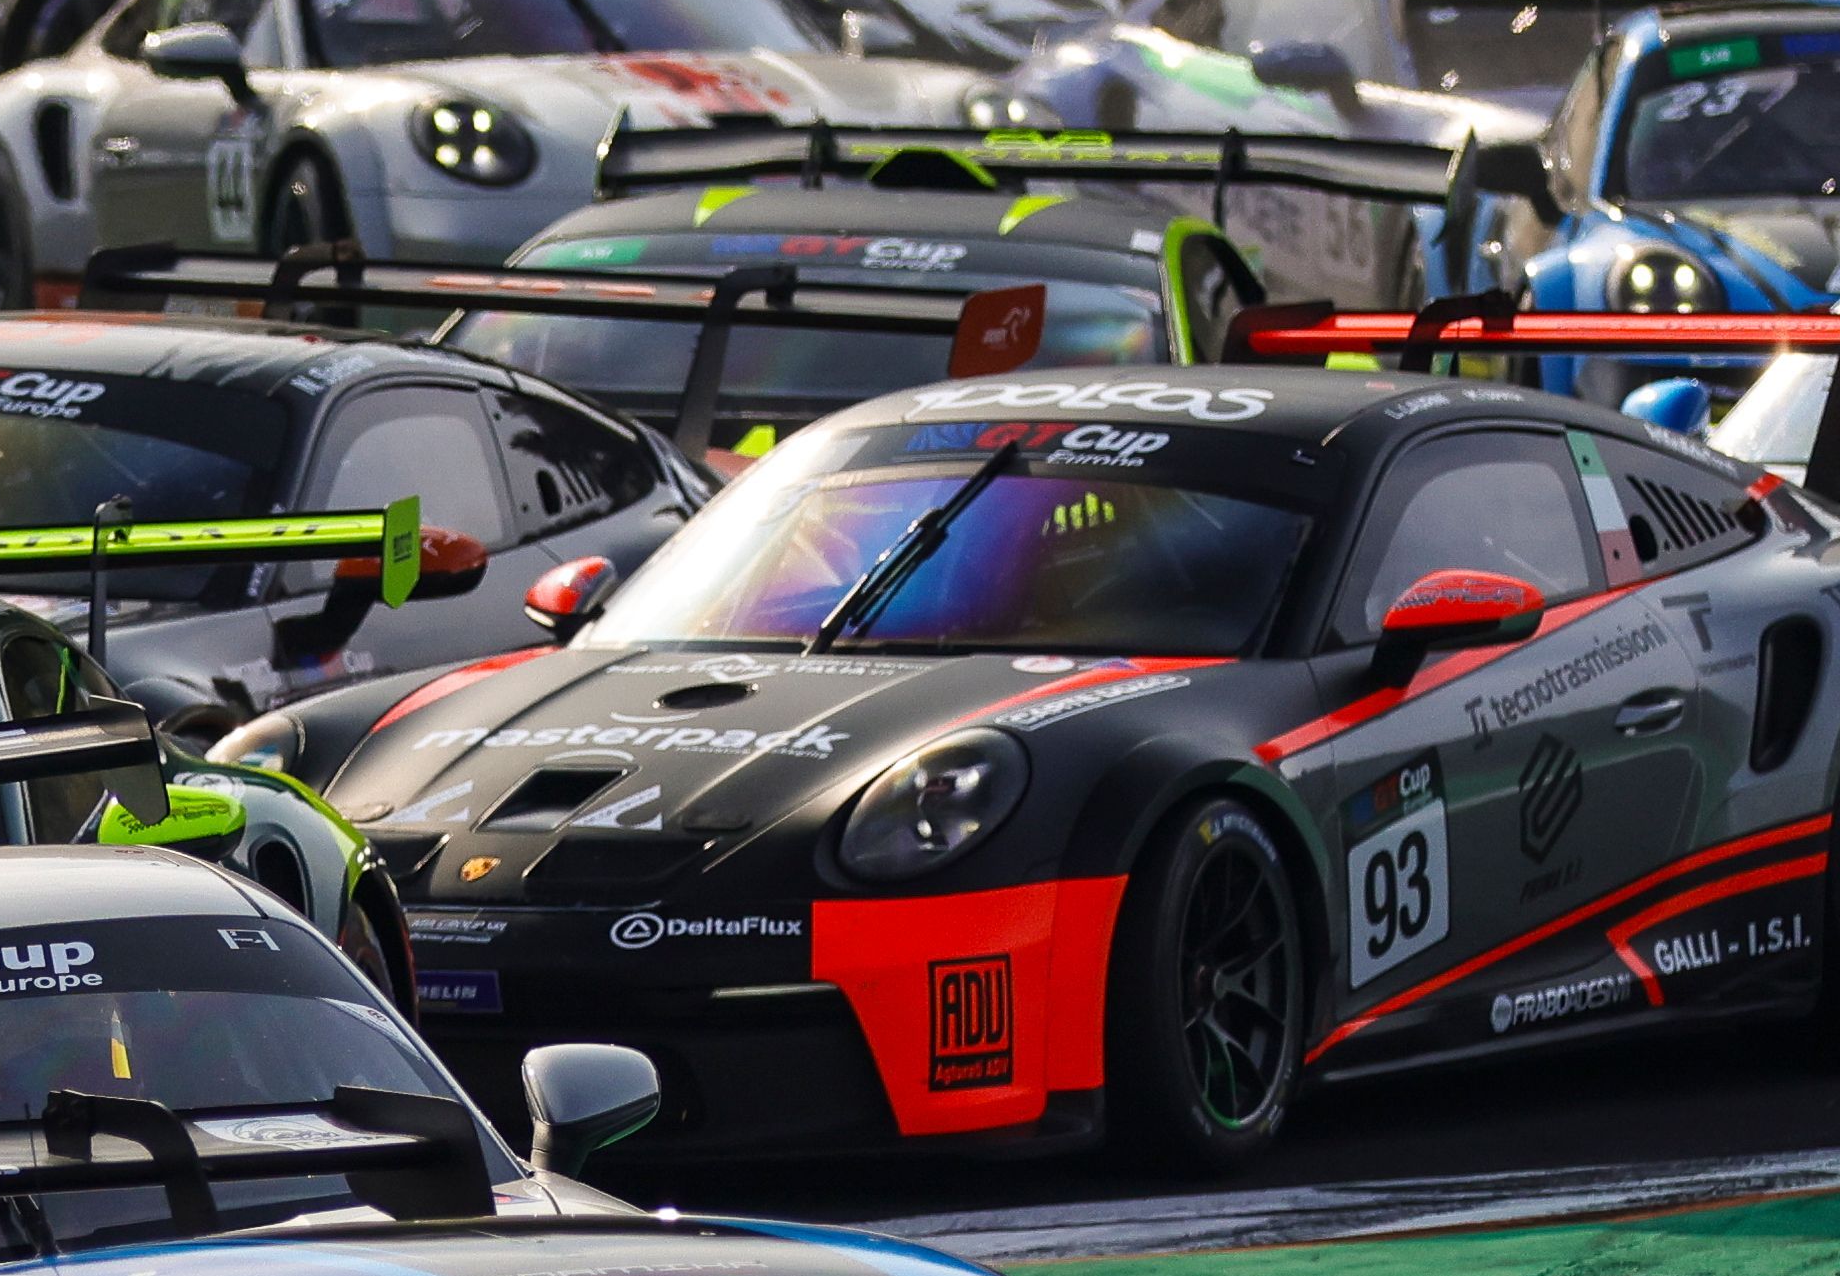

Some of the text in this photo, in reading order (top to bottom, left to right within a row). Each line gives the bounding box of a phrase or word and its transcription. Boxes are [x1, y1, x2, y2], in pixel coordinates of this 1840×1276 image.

[1658, 78, 1748, 121] 23
[862, 236, 967, 266] Cup
[976, 422, 1171, 456] GT Cup
[1490, 612, 1667, 729] tecnotrasmissioni
[412, 722, 853, 754] masterpack
[1399, 763, 1432, 799] Cup
[1362, 830, 1432, 960] 93
[666, 914, 803, 939] DeltaFlux
[1653, 929, 1722, 975] GALLI
[1747, 913, 1812, 957] I.S.I.
[418, 984, 478, 1001] HELIN
[940, 967, 1005, 1050] ADU
